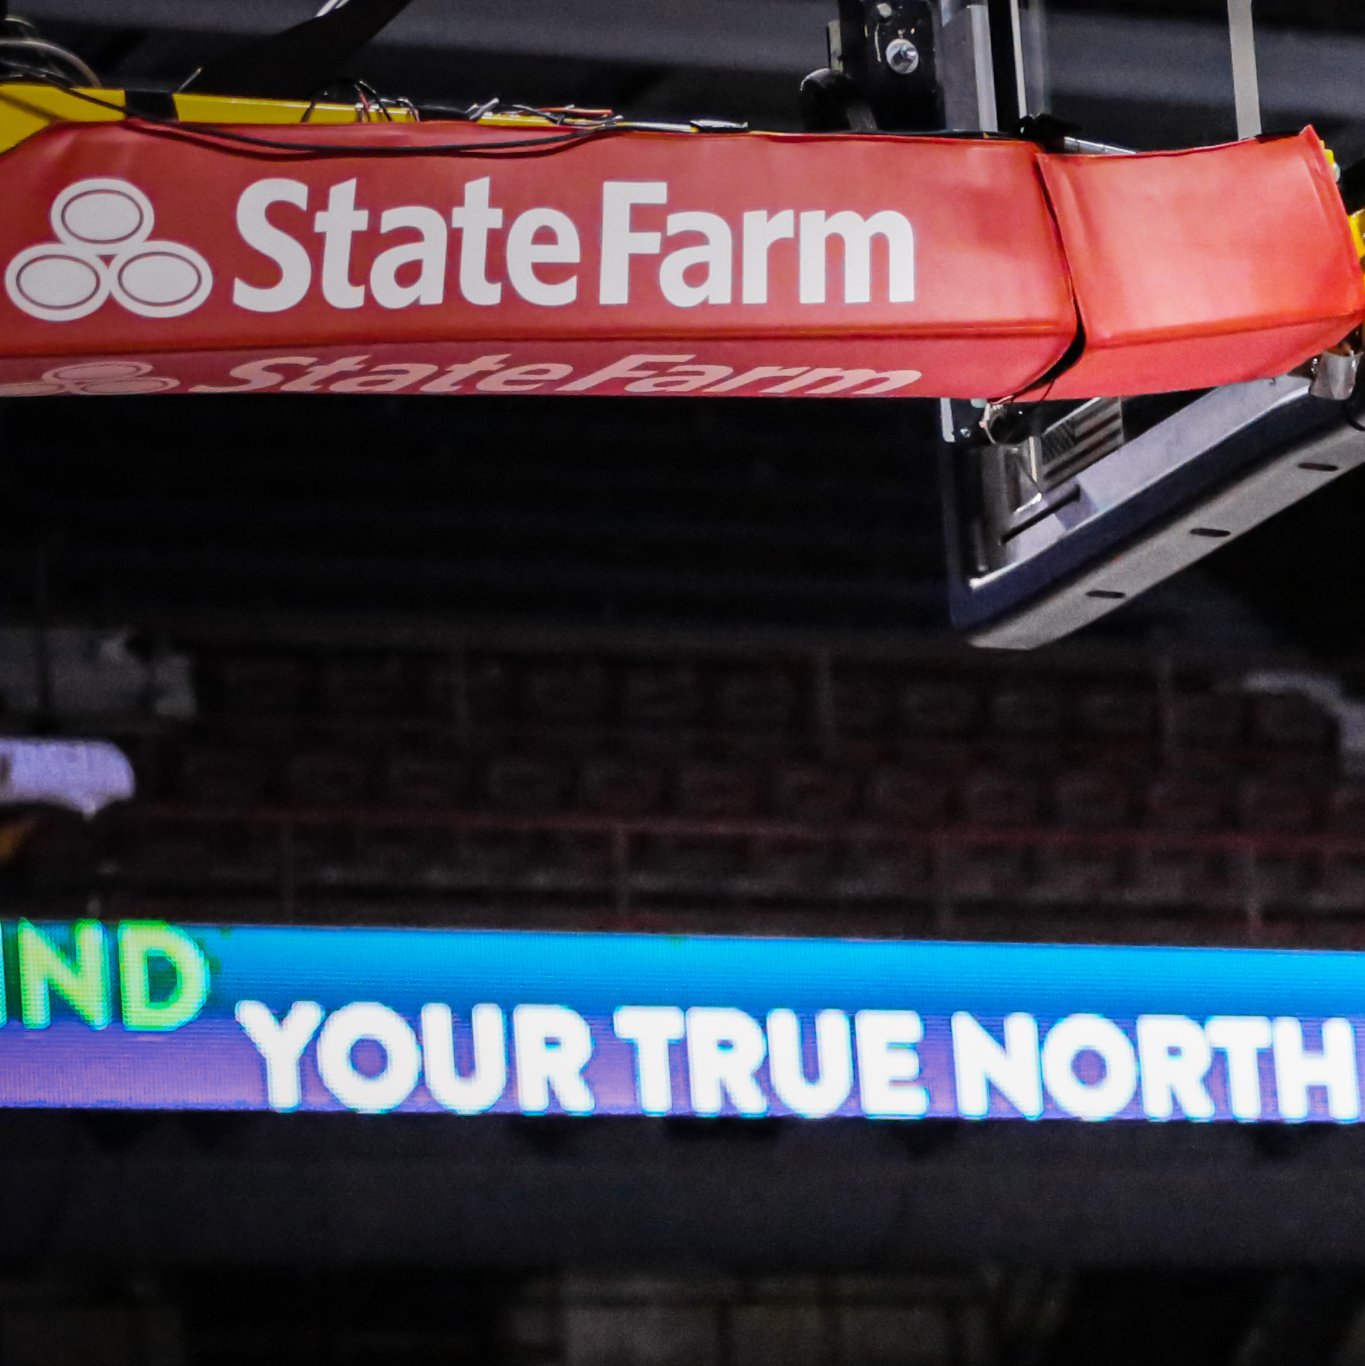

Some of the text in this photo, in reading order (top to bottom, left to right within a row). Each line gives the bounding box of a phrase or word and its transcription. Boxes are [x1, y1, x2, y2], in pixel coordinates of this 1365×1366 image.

[0, 916, 211, 1031] ND
[235, 1000, 1361, 1124] YOUR TRUE NORTH
